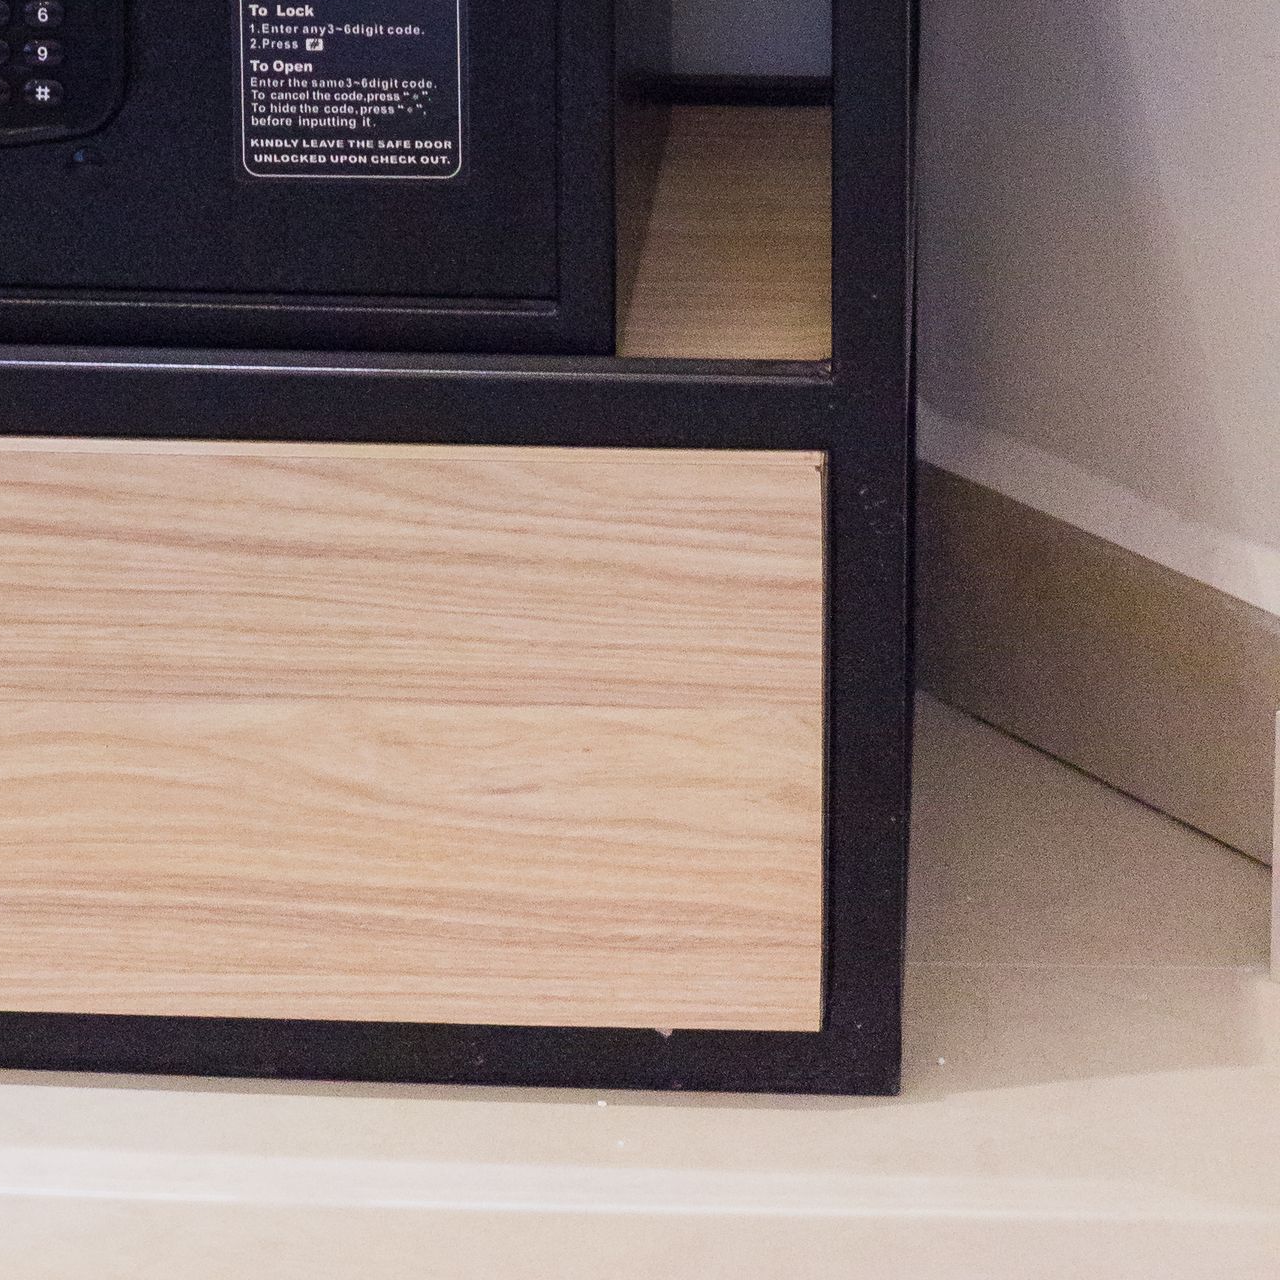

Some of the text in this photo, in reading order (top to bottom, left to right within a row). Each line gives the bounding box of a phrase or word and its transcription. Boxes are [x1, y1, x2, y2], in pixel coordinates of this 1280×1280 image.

[37, 8, 48, 22] 6
[249, 5, 314, 16] To Lock
[249, 24, 298, 34] 1.Enter
[387, 25, 425, 35] code.
[250, 39, 298, 49] 2.Press
[37, 46, 48, 62] 9
[250, 60, 313, 74] To Open
[250, 78, 284, 88] Enter
[288, 78, 308, 88] the
[402, 79, 437, 89] code.
[35, 85, 50, 101] #
[252, 91, 265, 100] To
[270, 90, 309, 100] cancel
[313, 90, 331, 100] the
[252, 103, 266, 113] To
[270, 103, 297, 113] hide
[300, 103, 319, 113] the
[251, 116, 376, 129] before inputting it.
[250, 139, 452, 150] KINDLY LEAVE THE SAFE DOOR
[254, 154, 451, 165] UNLOCKED UPON CHECK OUT.
